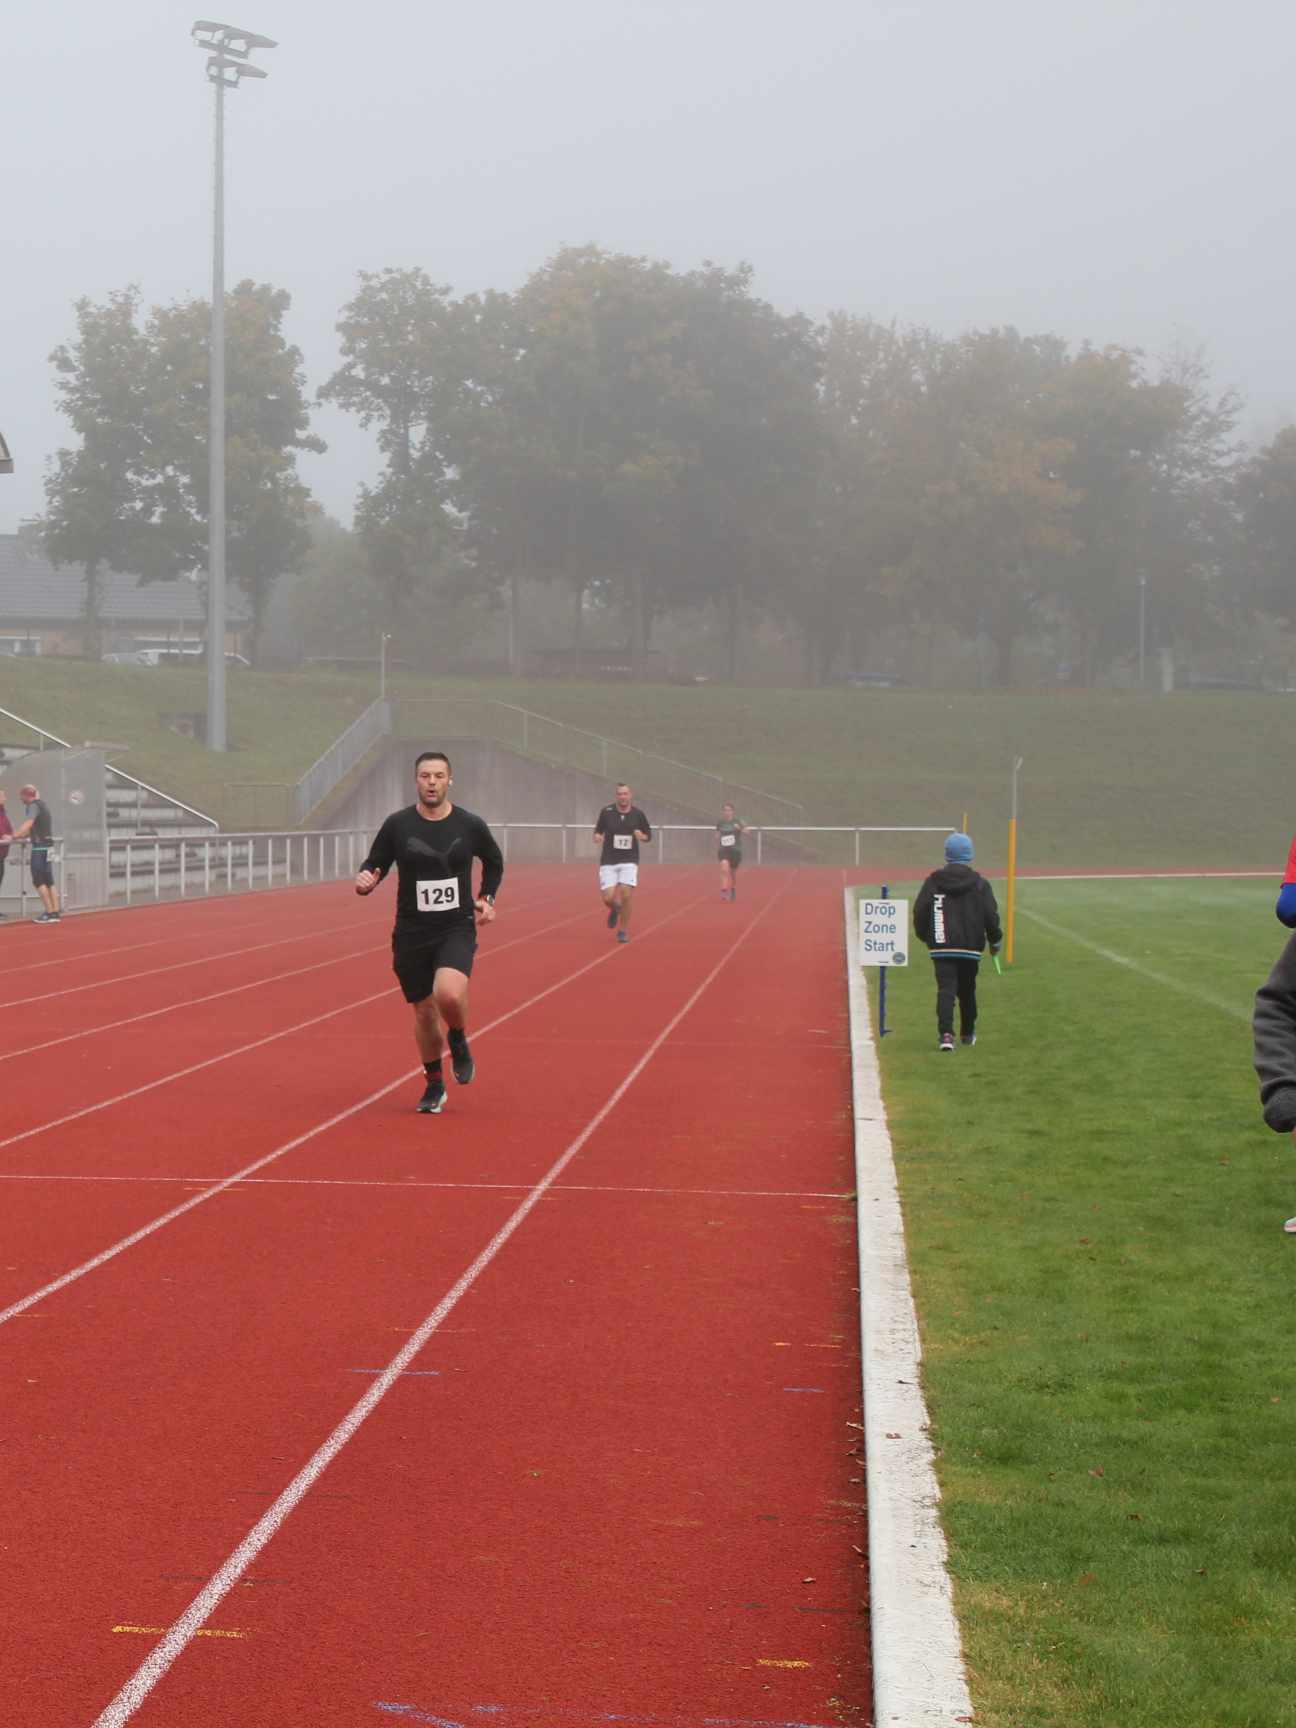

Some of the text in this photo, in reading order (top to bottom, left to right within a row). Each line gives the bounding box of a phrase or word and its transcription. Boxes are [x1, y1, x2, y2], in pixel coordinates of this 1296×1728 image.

[420, 886, 455, 905] 129
[864, 903, 896, 918] Drop
[864, 921, 896, 933] Zone
[864, 939, 895, 952] Start
